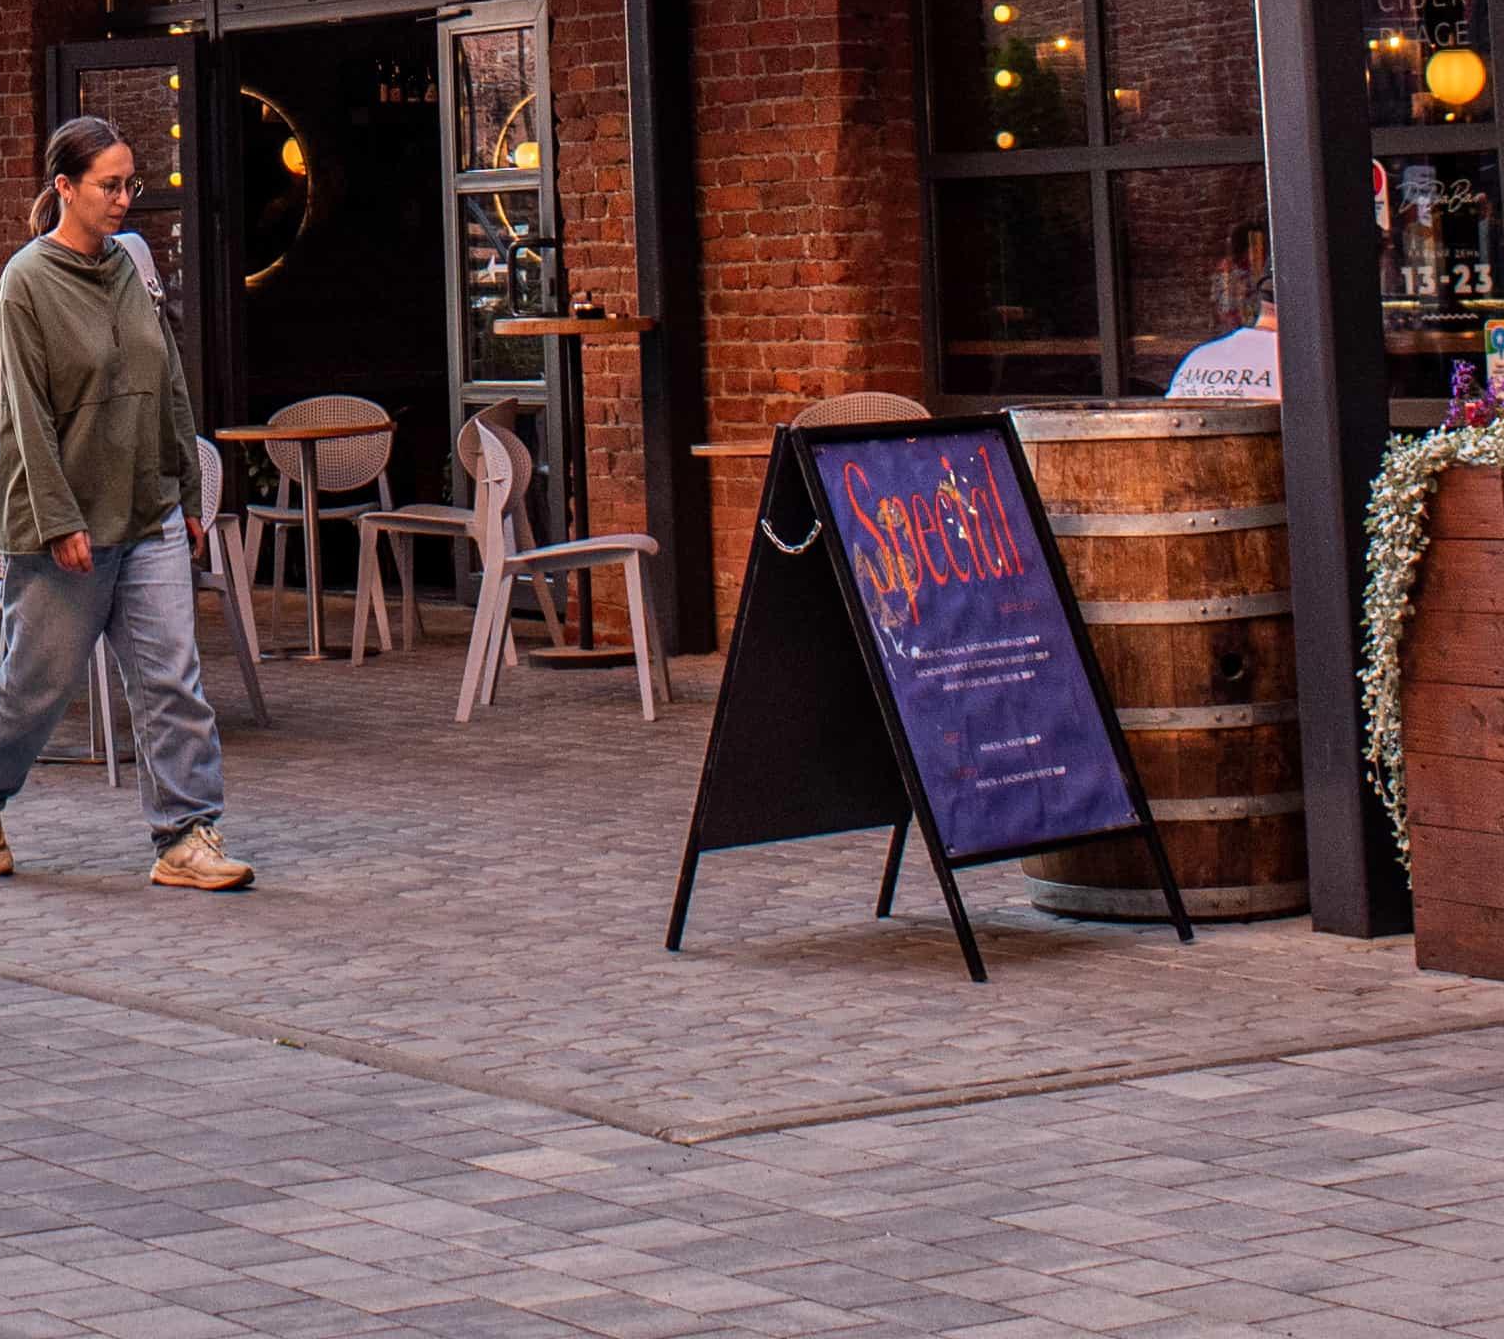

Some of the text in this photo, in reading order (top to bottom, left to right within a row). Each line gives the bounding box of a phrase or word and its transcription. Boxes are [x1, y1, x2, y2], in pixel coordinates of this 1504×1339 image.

[1378, 20, 1474, 47] PACE
[1400, 263, 1494, 297] 13-23
[844, 444, 1024, 626] Special
